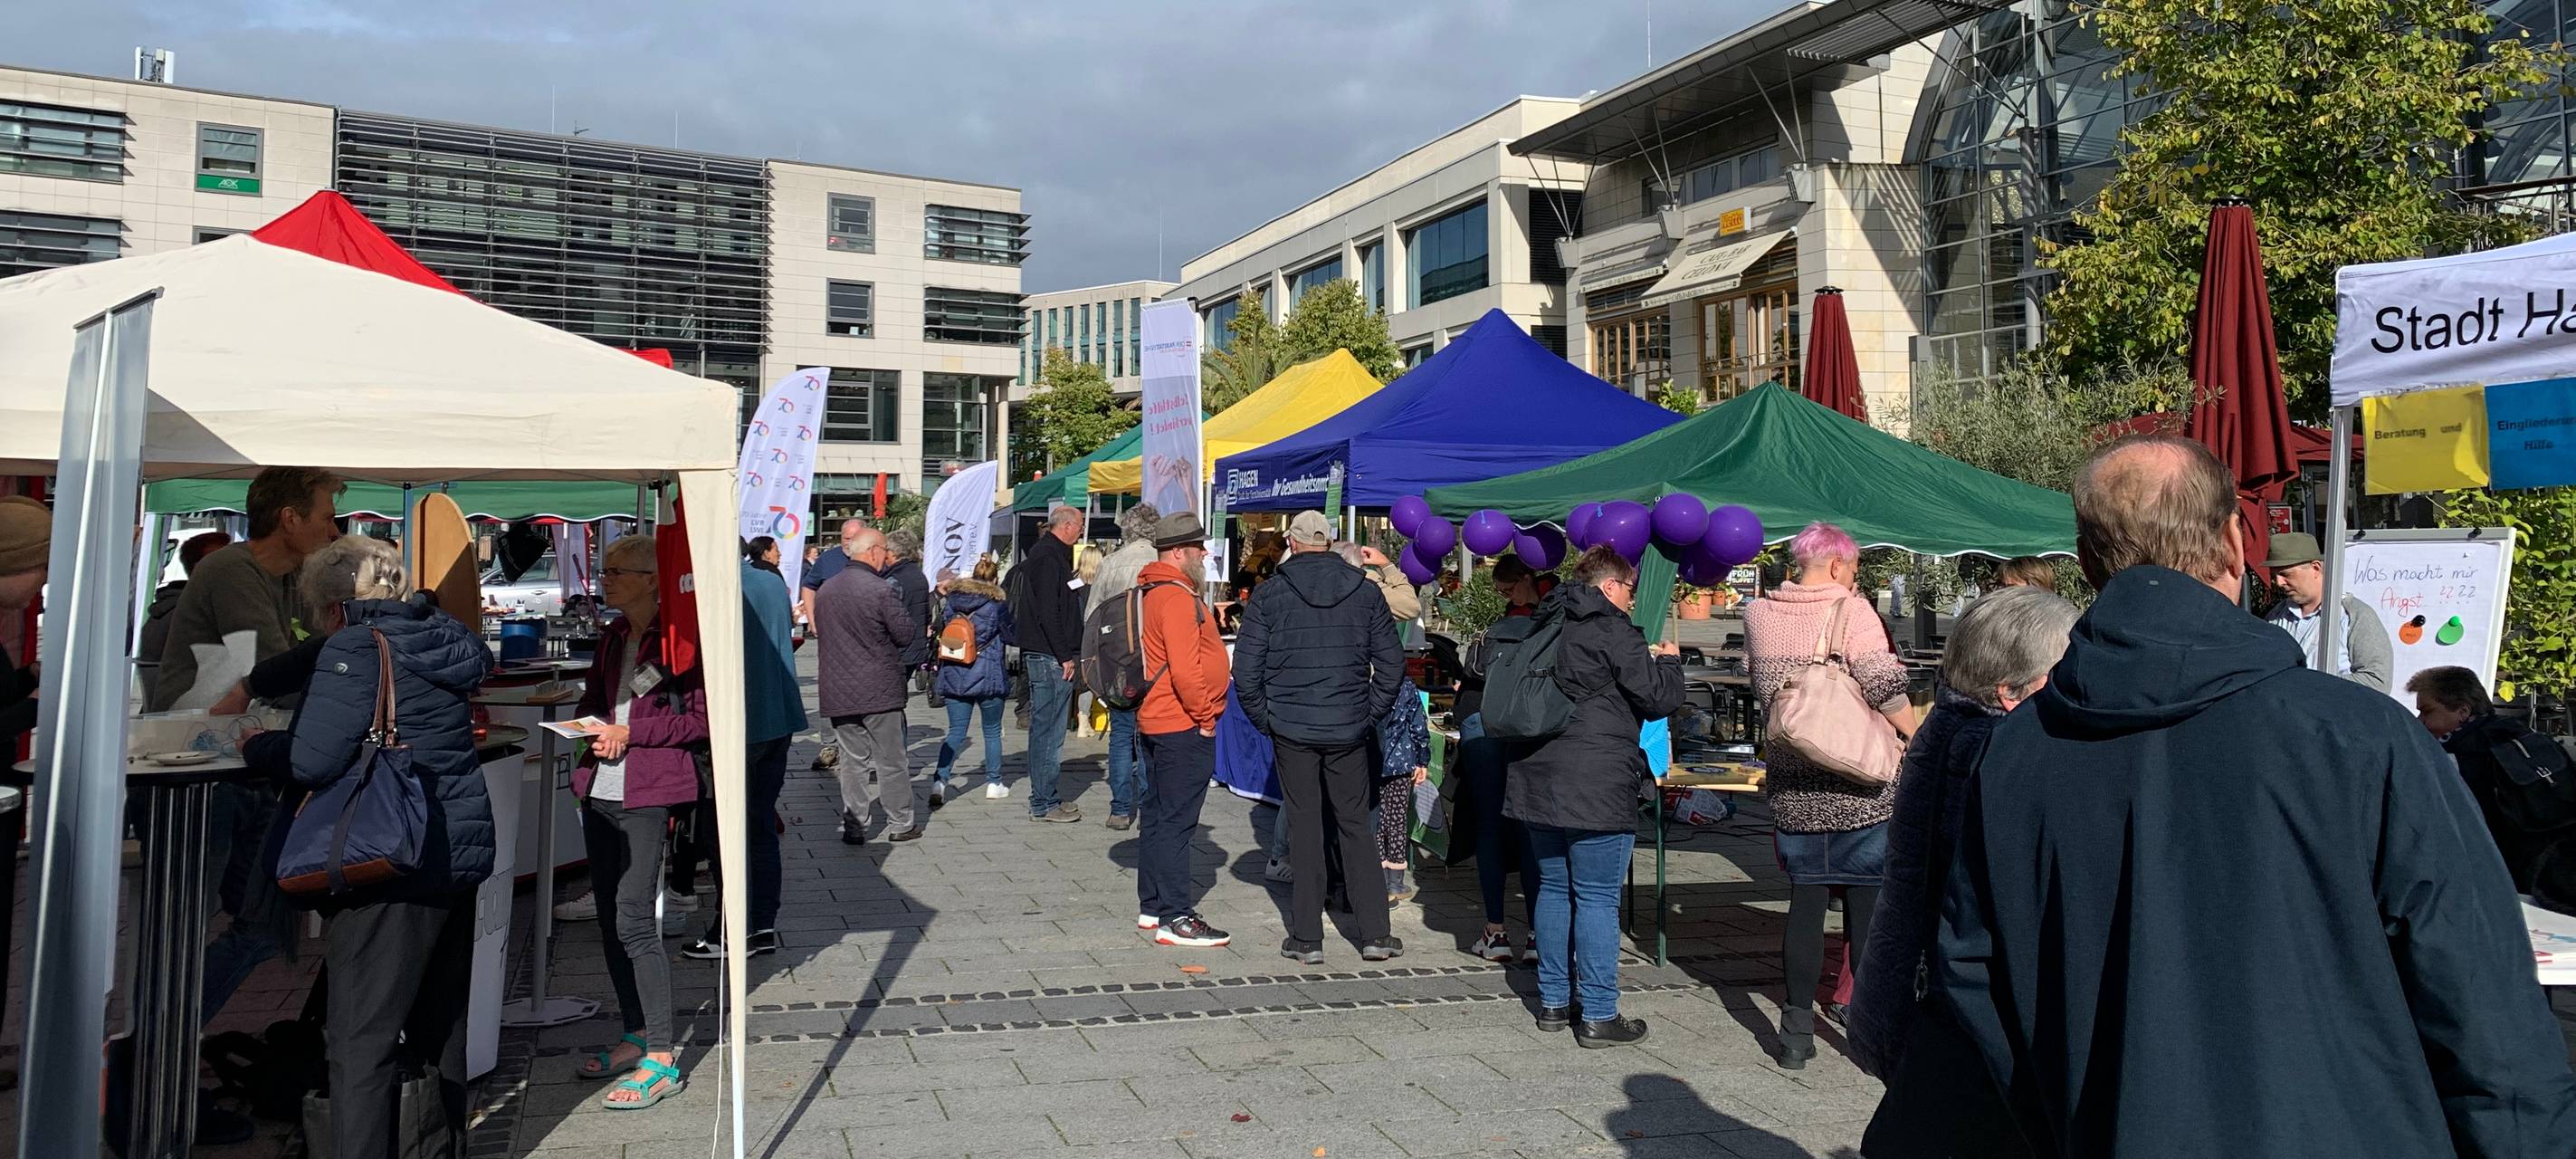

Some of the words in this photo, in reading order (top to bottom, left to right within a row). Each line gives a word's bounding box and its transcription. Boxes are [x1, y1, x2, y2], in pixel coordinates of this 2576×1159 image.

[2371, 297, 2504, 353] Stadt
[2374, 427, 2427, 440] Beratung
[2440, 423, 2462, 434] und
[2524, 439, 2554, 451] Hilfe
[1238, 469, 1259, 489] HAGEN
[1280, 473, 1331, 496] Gesundheitsamt
[769, 505, 800, 540] 70
[2353, 555, 2388, 585] Was
[2393, 564, 2444, 581] macht
[2452, 567, 2479, 580] mir
